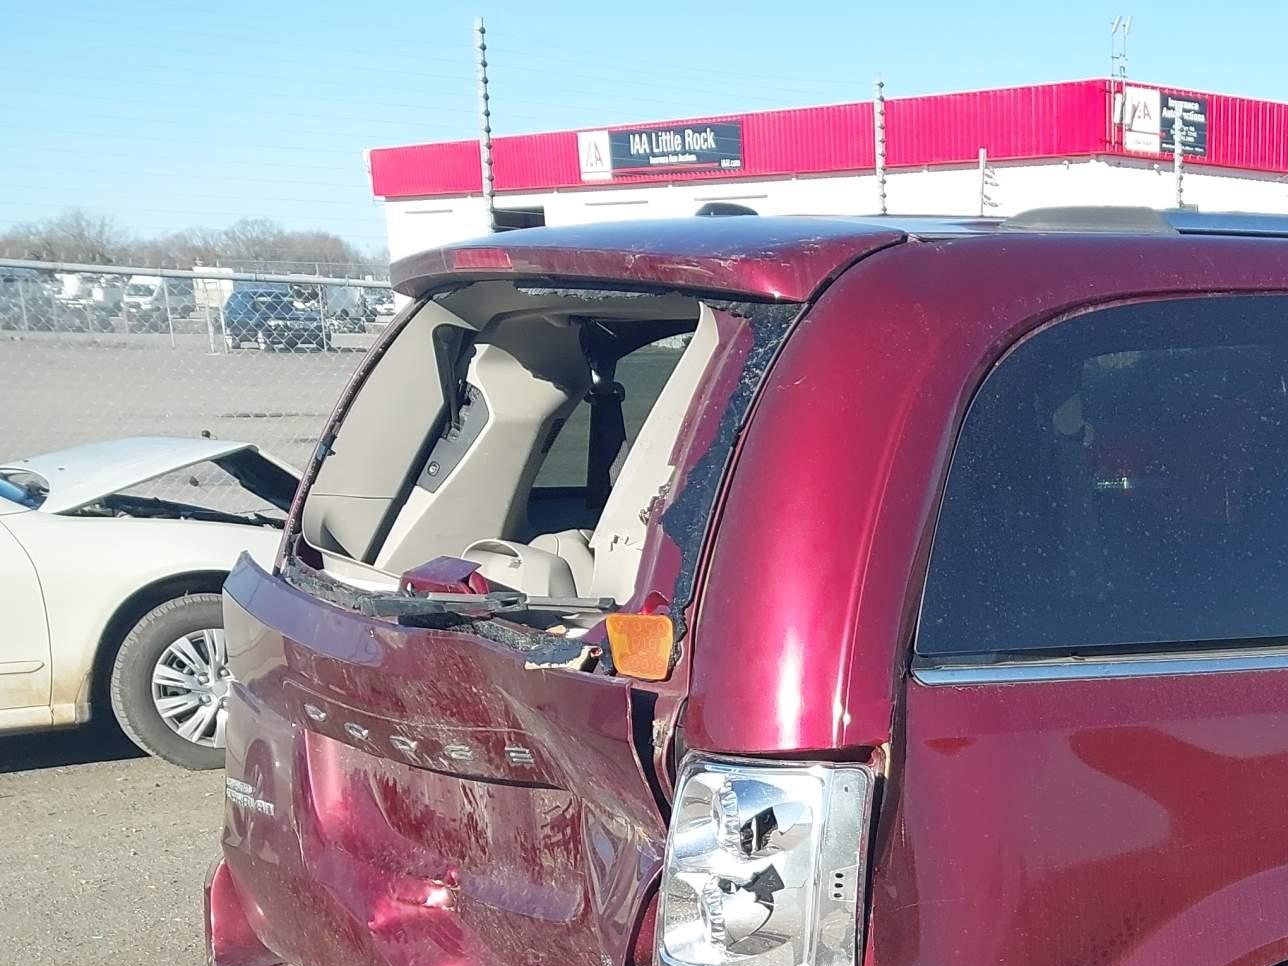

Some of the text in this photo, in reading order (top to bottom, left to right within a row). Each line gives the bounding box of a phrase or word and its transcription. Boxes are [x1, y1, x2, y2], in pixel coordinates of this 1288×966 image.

[629, 133, 651, 155] IAA
[651, 130, 682, 153] Little
[684, 127, 716, 151] Rock
[303, 703, 535, 768] DODGE
